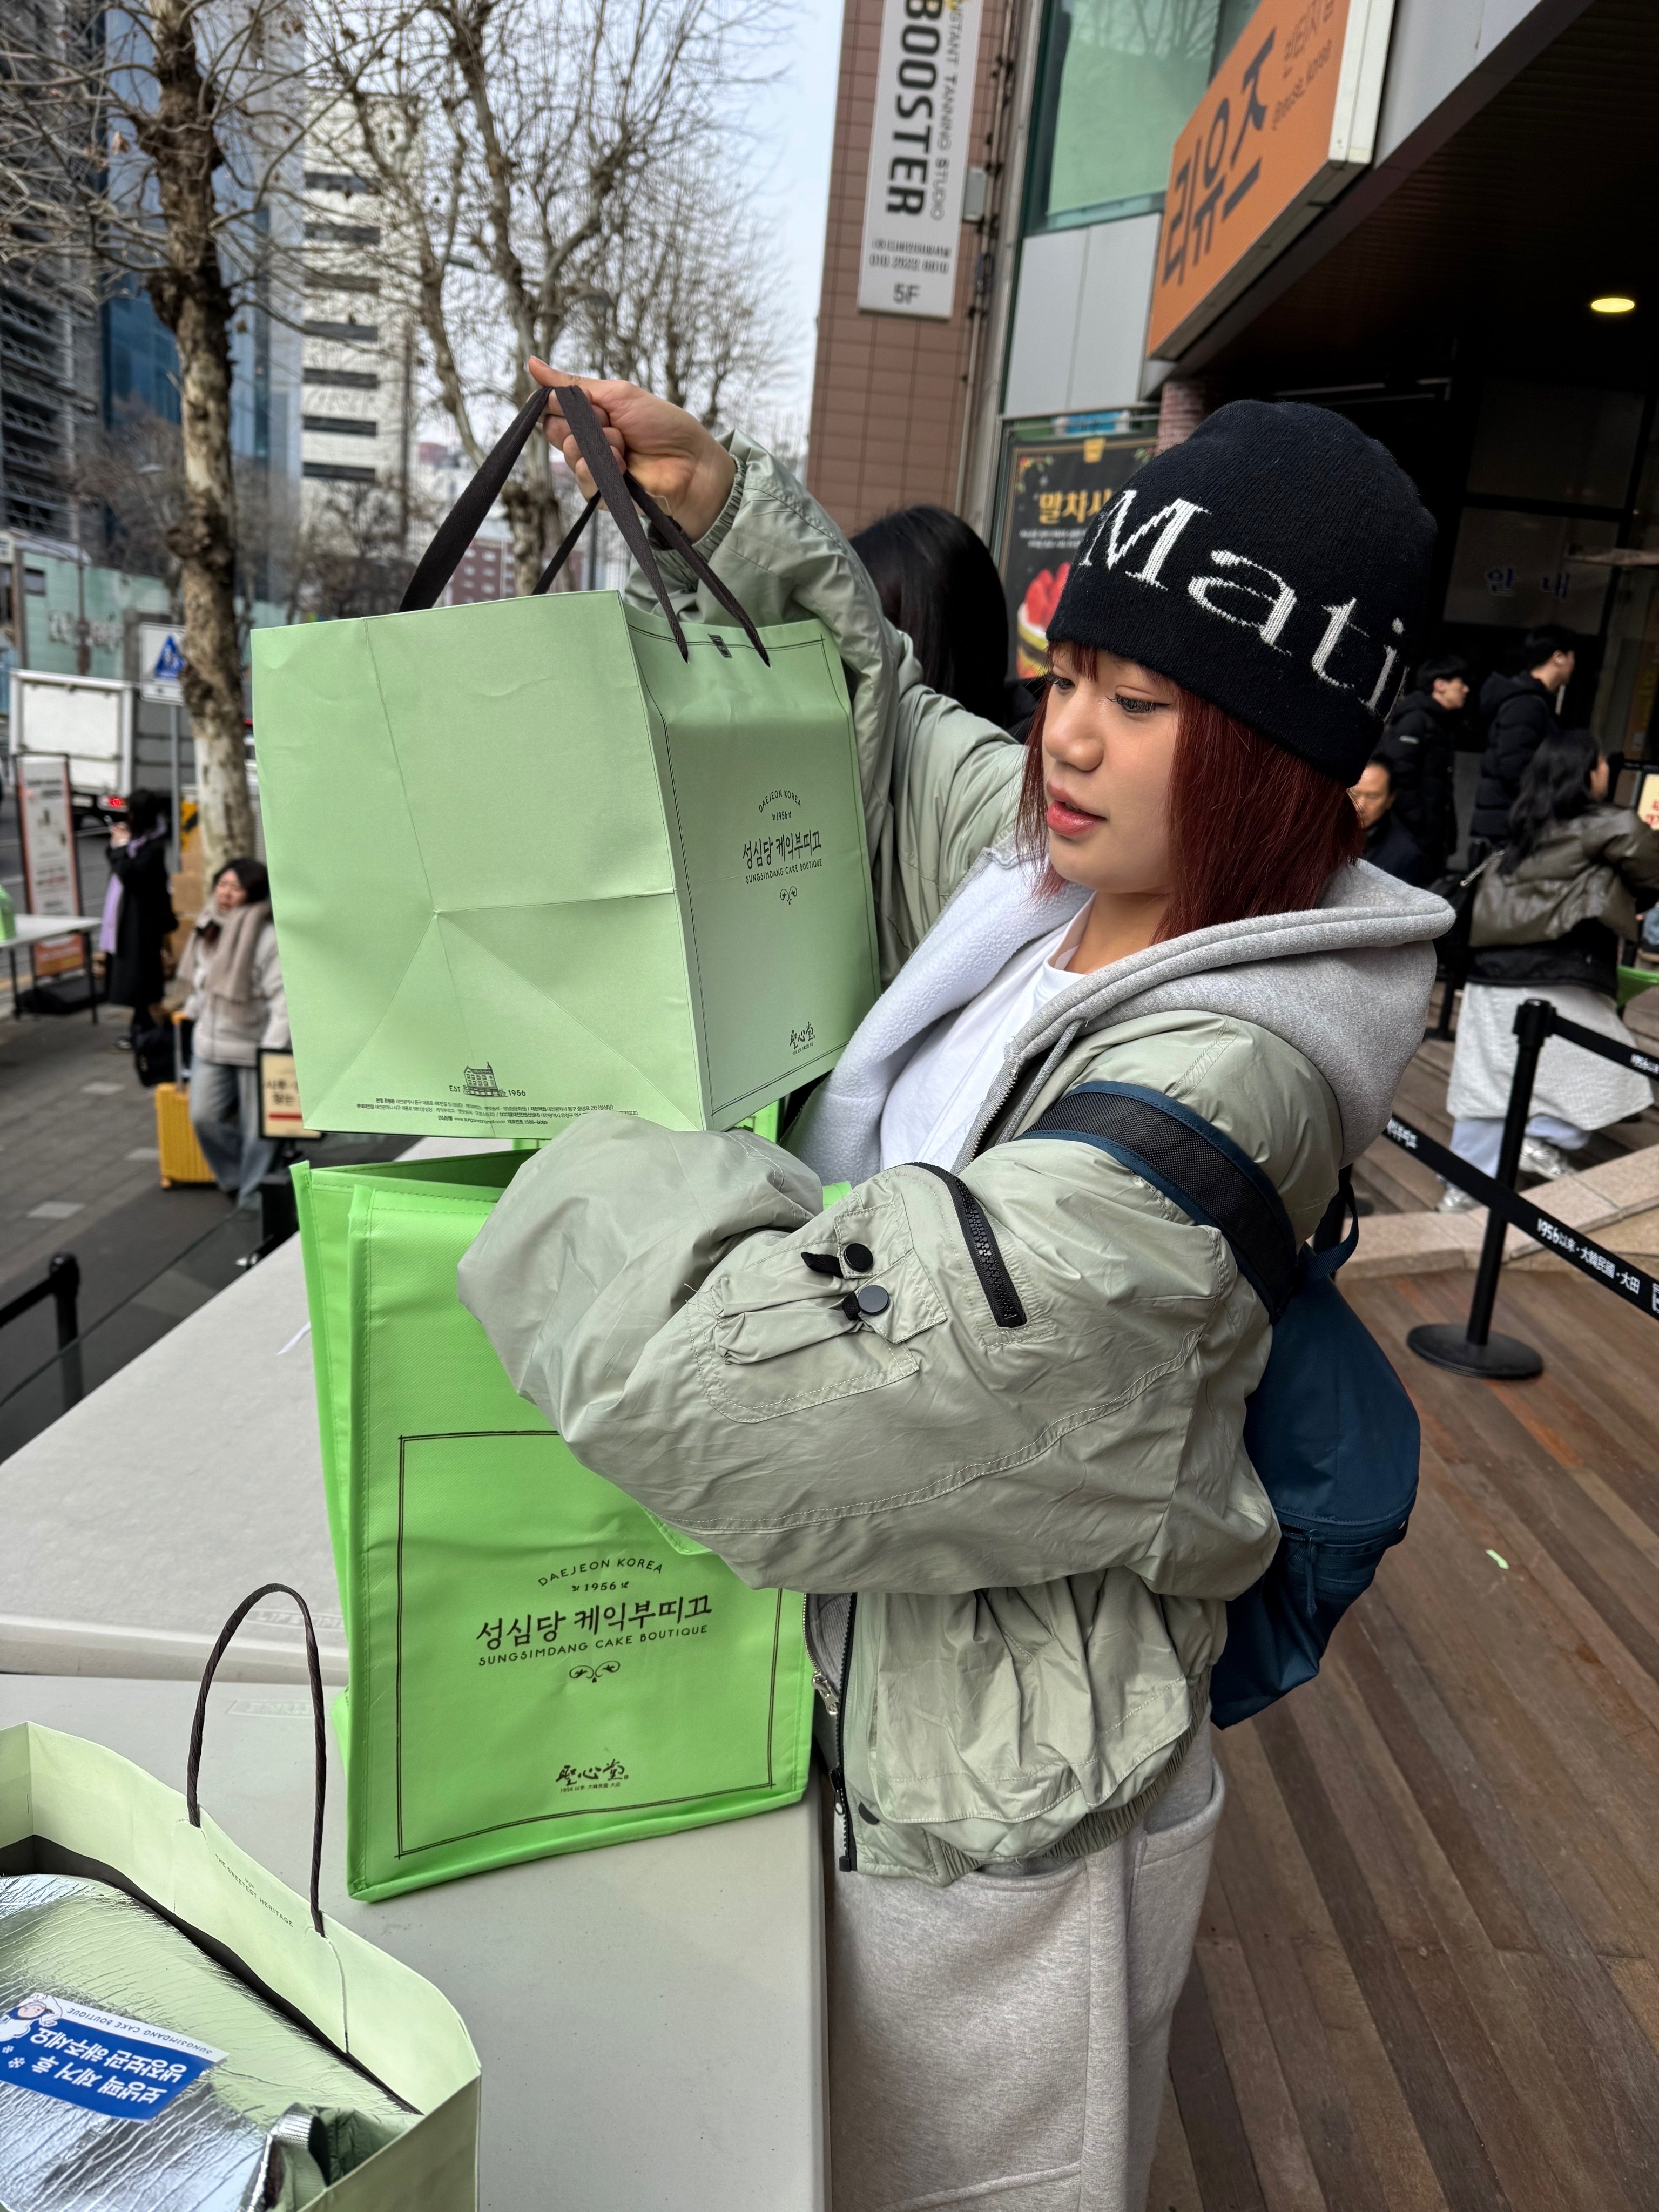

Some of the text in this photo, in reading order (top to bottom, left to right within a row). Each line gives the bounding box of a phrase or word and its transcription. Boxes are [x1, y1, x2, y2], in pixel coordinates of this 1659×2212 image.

[885, 0, 944, 217] BOOSTER
[930, 157, 950, 221] STUDIO
[893, 281, 921, 305] 5F
[1080, 489, 1410, 724] Mati
[759, 789, 801, 813] DAEJEON KOREA
[776, 811, 788, 821] 1956
[743, 829, 822, 870] 성심당 케익부띠끄
[745, 859, 822, 884] SUNGSIMDANG CAKE BOUTIQUE
[449, 1084, 461, 1093] EST
[538, 1557, 663, 1586] DAEJEON KOREA
[584, 1581, 617, 1592] 1956
[476, 1594, 713, 1650] 성심당 케익부띠끄
[478, 1624, 709, 1667] SUNGSIMDANG CAKE BOUTIQUE
[215, 1853, 294, 1928] THE SWEETEST HERITAGE
[66, 2007, 213, 2055] SUNGSIMDANG CAKE BOUTIQUE
[29, 2027, 187, 2083] 냉장보관 해주세요
[31, 2055, 168, 2105] 보냉팩 제거 후
